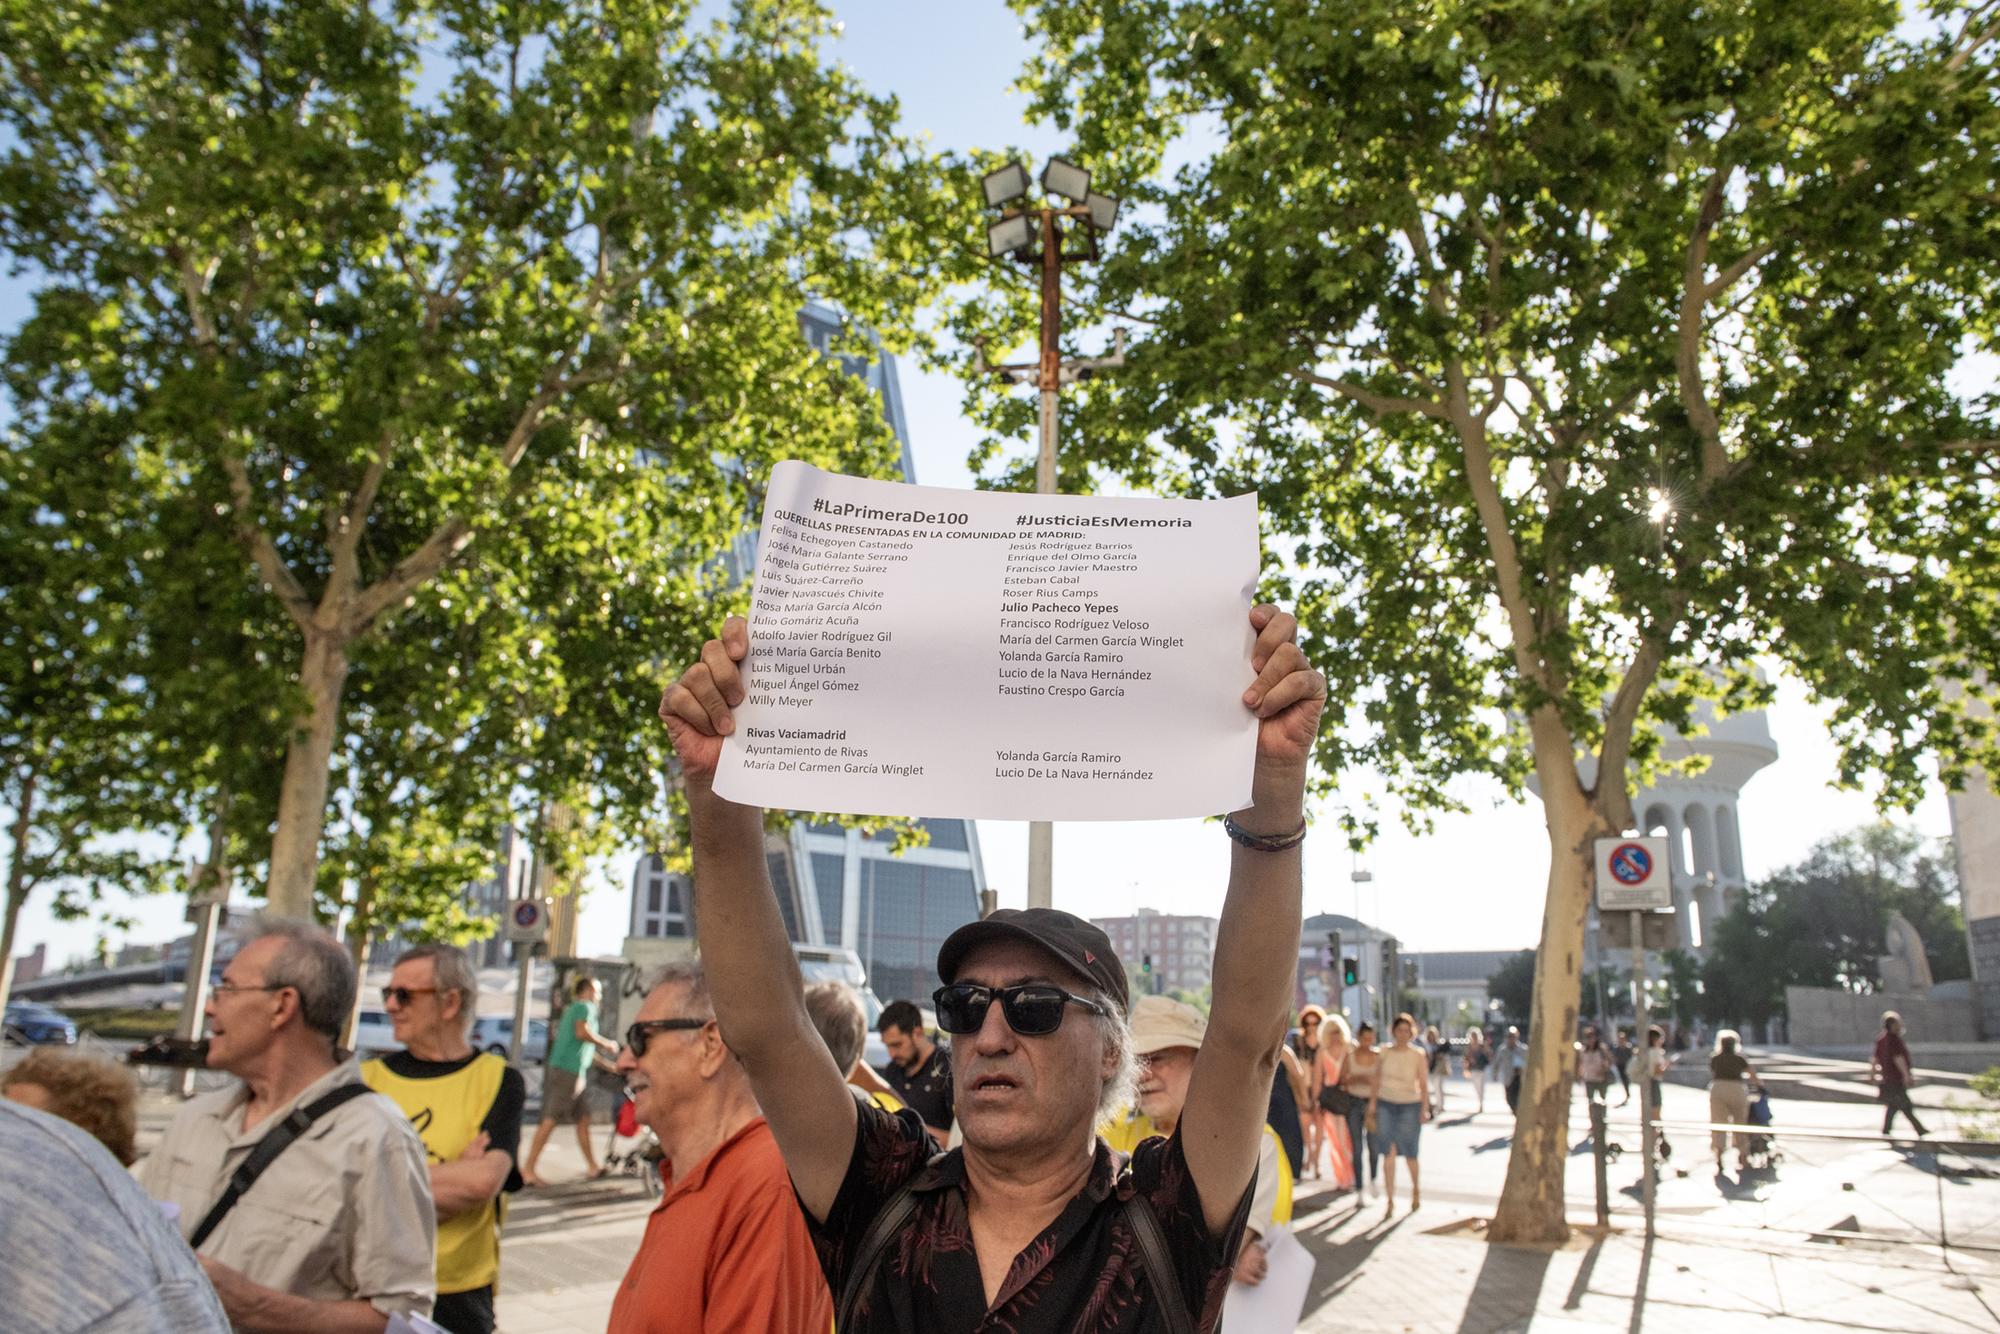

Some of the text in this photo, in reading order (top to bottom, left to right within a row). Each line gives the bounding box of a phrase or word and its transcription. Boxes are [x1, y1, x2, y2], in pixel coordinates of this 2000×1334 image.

[813, 498, 968, 524] #LaPrimeraDe100
[774, 509, 832, 532] QUERELLAS
[835, 524, 910, 538] PRESENTADAS
[913, 530, 927, 538] EN
[930, 531, 943, 539] LA
[946, 531, 1016, 539] COMUNIDAD
[1037, 531, 1086, 539] MADRID:
[1016, 515, 1192, 527] #JusticiaEsMemoria
[771, 524, 913, 550] Felisa Echegoyen Castanedo
[768, 539, 908, 561] José María Galante Serrano
[1039, 542, 1092, 551] Rodríguez
[1008, 553, 1048, 562] Enrique
[802, 562, 850, 573] Gutiérrez
[853, 564, 887, 573] Suárez
[1006, 564, 1055, 572] Francisco
[1058, 564, 1090, 572] Javier
[761, 570, 863, 585] Luis Suárez-Carreño
[1050, 576, 1080, 584] Cabal
[758, 584, 884, 598] Javier Navascués Chivite
[1002, 589, 1034, 597] Roser
[1061, 589, 1098, 600] Camps
[756, 600, 882, 612] Rosa María García Alcón
[1001, 603, 1119, 615] Julio Pacheco Yepes
[753, 616, 859, 626] Julio Gomáriz Acuña
[1001, 618, 1149, 632] Francisco Rodríguez Veloso
[751, 631, 892, 643] Adolfo Javier Rodríguez Gil
[1000, 634, 1184, 649] María del Carmen García Winglet
[751, 646, 881, 658] José María García Benito
[999, 651, 1123, 663] Yolanda García Ramiro
[752, 663, 845, 676] Luis Miguel Urbán
[999, 668, 1152, 680] Lucio de la Nava Hernández
[750, 677, 859, 692] Miguel Ángel Gómez
[999, 685, 1125, 698] Faustino Crespo García
[749, 695, 813, 708] Willy Meyer
[747, 728, 846, 740] Rivas Vaciamadrid
[746, 744, 868, 758] Ayuntamiento de Rivas
[996, 751, 1121, 762] Yolanda García Ramiro
[744, 760, 924, 778] María Del Carmen García Winglet
[995, 767, 1153, 780] Lucio De La Nava Hernández
